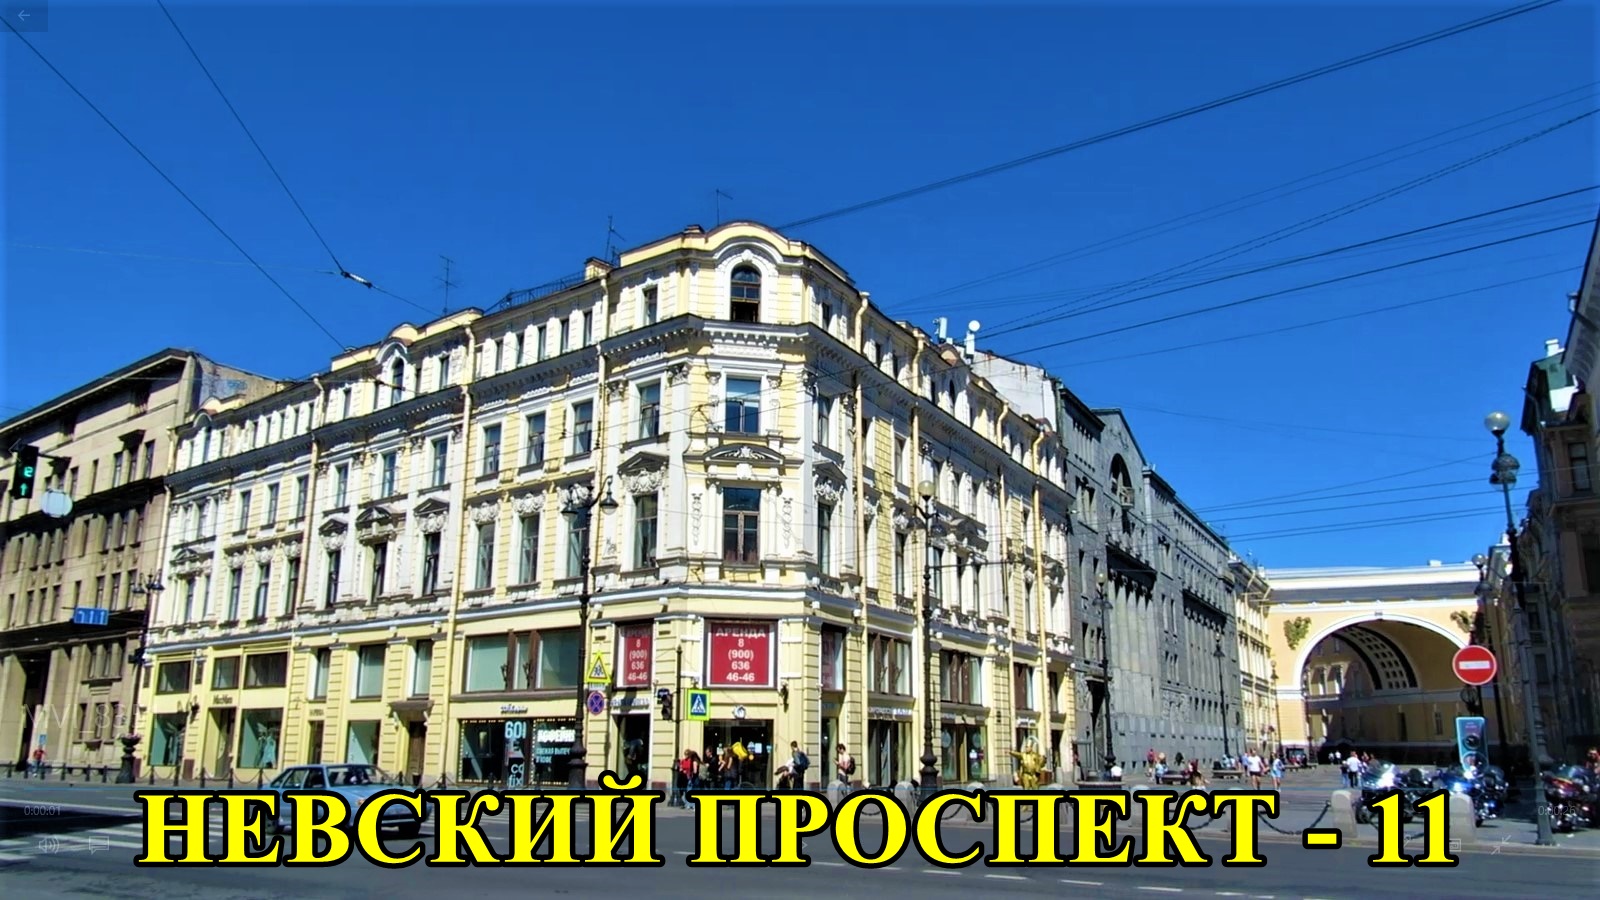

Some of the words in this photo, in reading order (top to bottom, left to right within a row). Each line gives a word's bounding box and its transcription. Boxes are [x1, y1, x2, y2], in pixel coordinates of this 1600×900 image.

[715, 627, 766, 639] АРЕНДА
[636, 638, 641, 648] 8
[738, 638, 744, 648] 8
[629, 650, 648, 661] (900)
[728, 649, 754, 661] (900)
[631, 661, 645, 670] 636
[731, 661, 750, 671] 636
[628, 672, 648, 681] 46-46
[726, 672, 755, 682] 46-46
